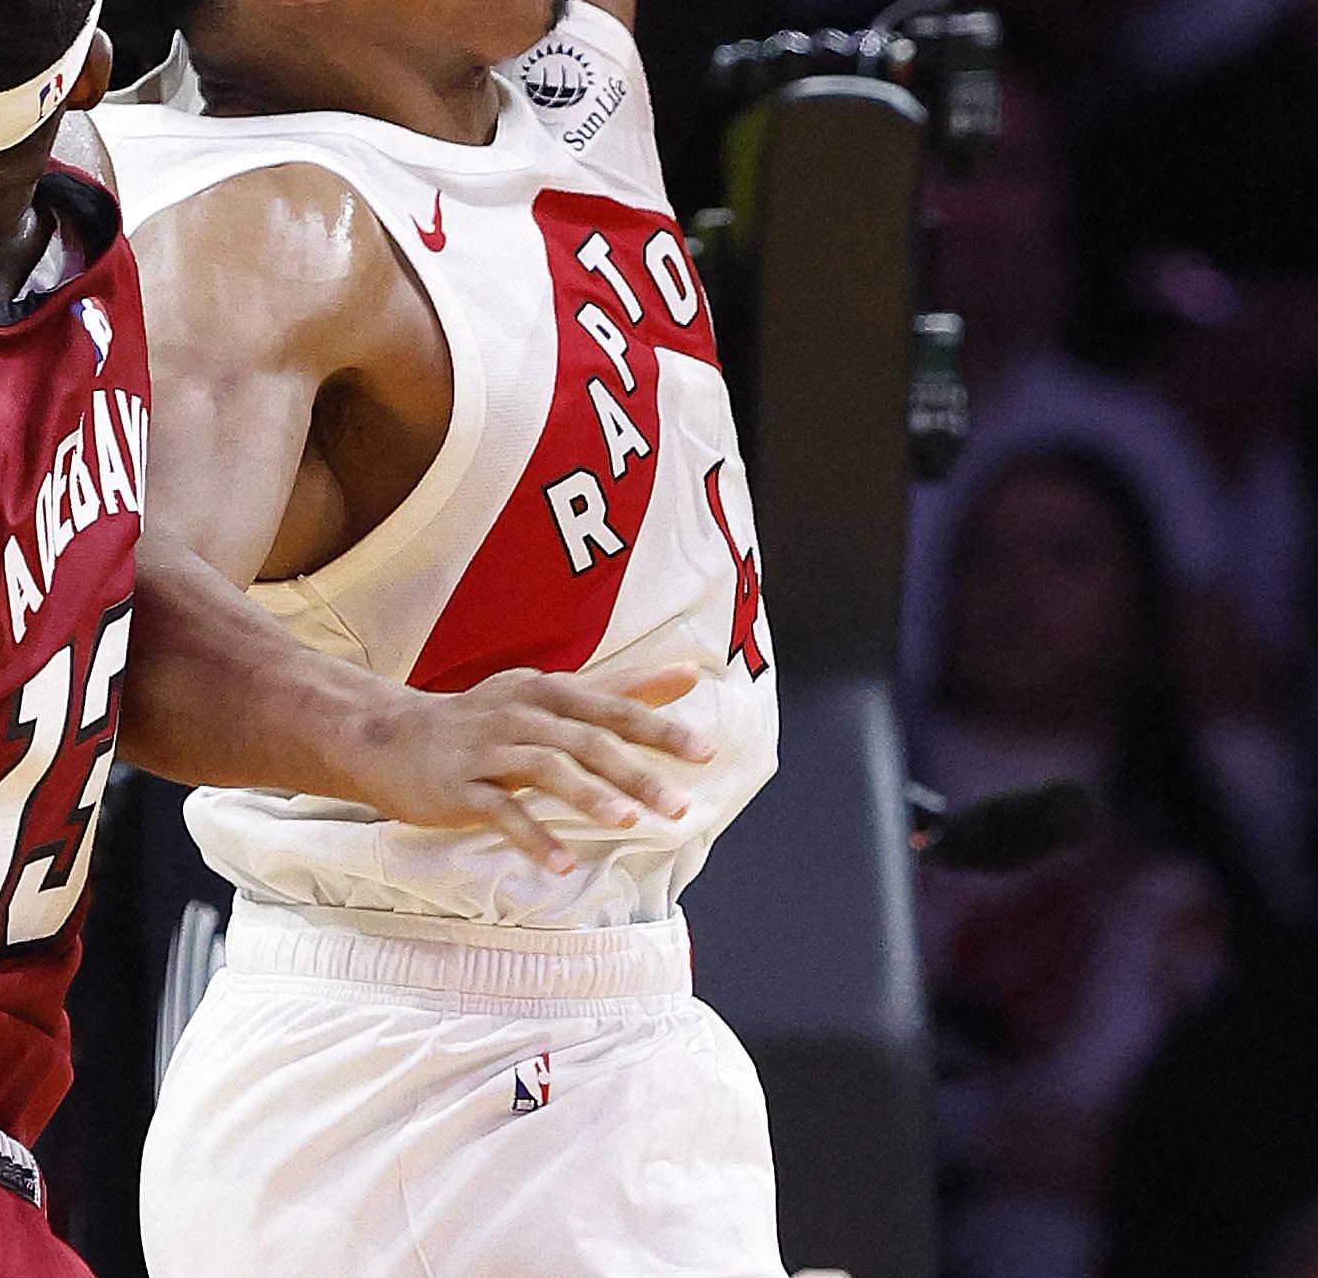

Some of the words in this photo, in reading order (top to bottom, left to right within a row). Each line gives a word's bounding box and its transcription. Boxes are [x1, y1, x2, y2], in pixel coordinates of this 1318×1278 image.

[562, 111, 605, 152] Sun
[594, 77, 627, 117] Life
[3, 388, 150, 645] ADEBAY
